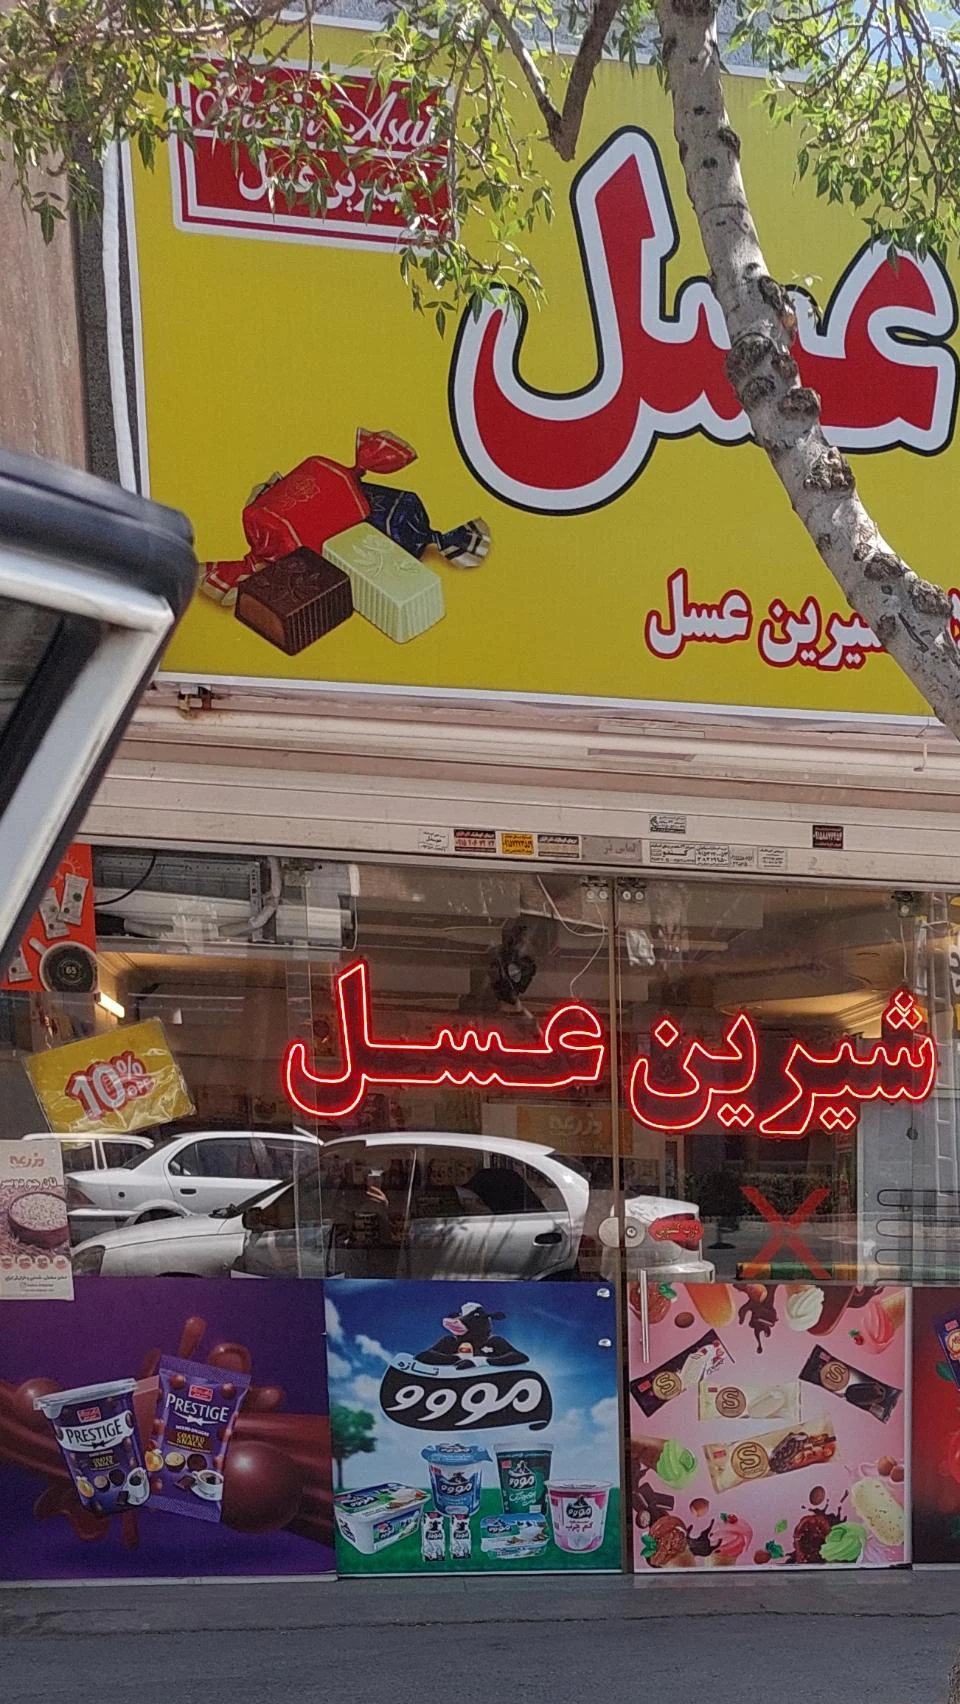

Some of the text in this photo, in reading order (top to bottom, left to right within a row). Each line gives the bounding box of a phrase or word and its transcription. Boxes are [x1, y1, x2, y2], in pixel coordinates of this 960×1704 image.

[645, 568, 752, 659] عسل
[286, 960, 937, 1136] شیرین عسل
[67, 1051, 147, 1120] 10%
[25, 1178, 41, 1191] جو
[42, 1176, 58, 1190] نان
[165, 1392, 230, 1423] PRESTIGE
[385, 1378, 543, 1426] مووو
[65, 1418, 124, 1444] PRESTIGE
